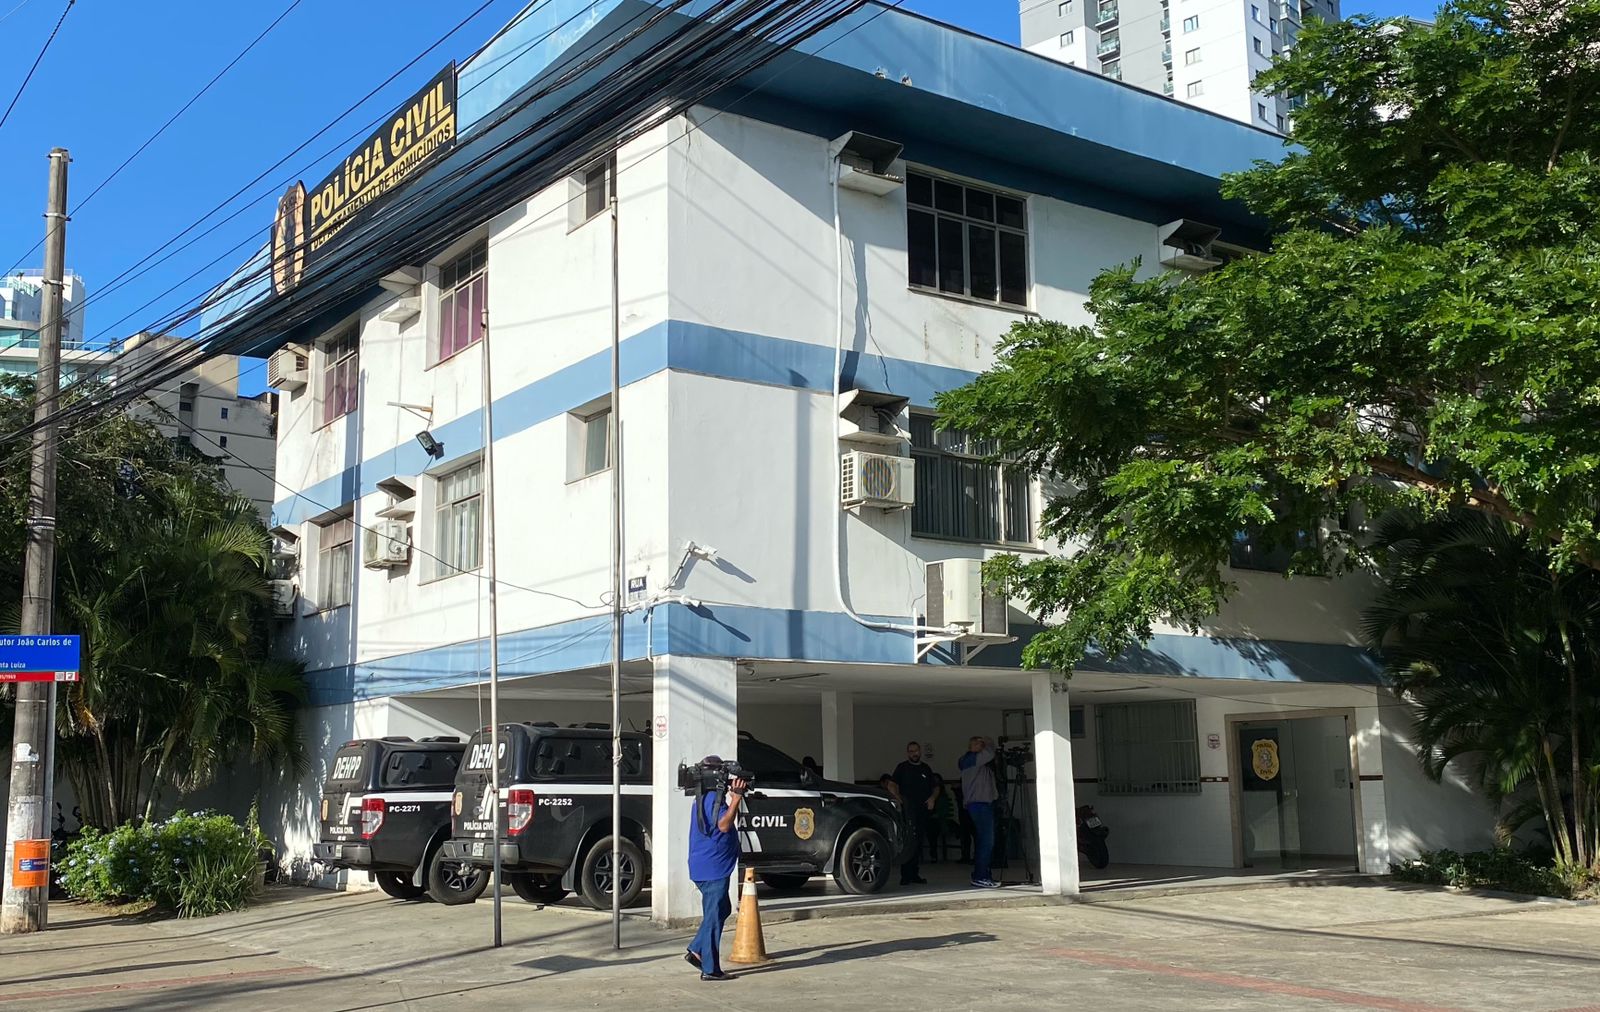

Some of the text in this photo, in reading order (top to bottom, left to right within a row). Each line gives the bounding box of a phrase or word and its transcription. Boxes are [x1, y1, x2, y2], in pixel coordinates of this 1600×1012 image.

[310, 81, 451, 230] POLÍCIA CIVIL
[378, 173, 390, 193] DE
[392, 124, 451, 183] HOMICÍDIOS
[17, 637, 35, 646] João
[37, 638, 61, 646] Carlos
[63, 638, 72, 646] de
[469, 742, 506, 769] DEHP
[333, 756, 362, 780] DEHPP
[389, 804, 421, 813] PC-2271
[538, 798, 573, 806] PC-2252
[463, 820, 482, 831] POLÍCIA
[751, 815, 788, 828] CIVIL
